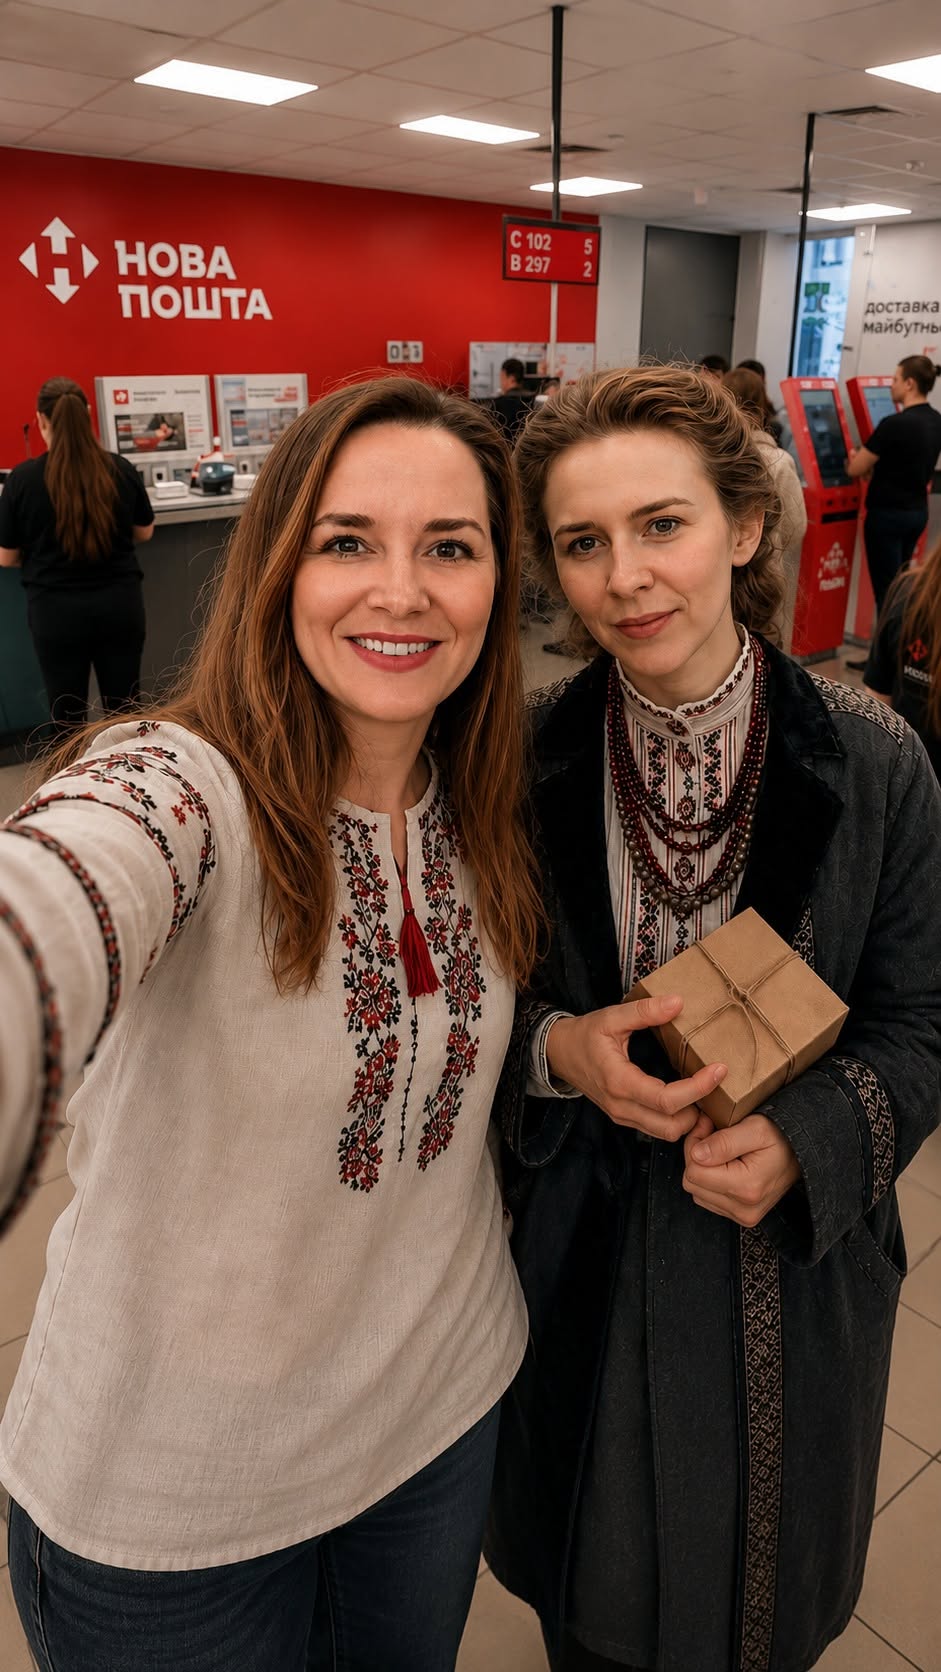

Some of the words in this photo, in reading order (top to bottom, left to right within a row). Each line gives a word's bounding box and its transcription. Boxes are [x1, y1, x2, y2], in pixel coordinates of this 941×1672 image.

[526, 232, 552, 251] 102
[583, 238, 593, 255] 5
[114, 240, 237, 280] НОВА
[525, 255, 551, 274] 297
[583, 261, 592, 277] 2
[118, 284, 273, 320] ПОШТА
[864, 301, 940, 316] доставка
[863, 318, 941, 338] майбутнь
